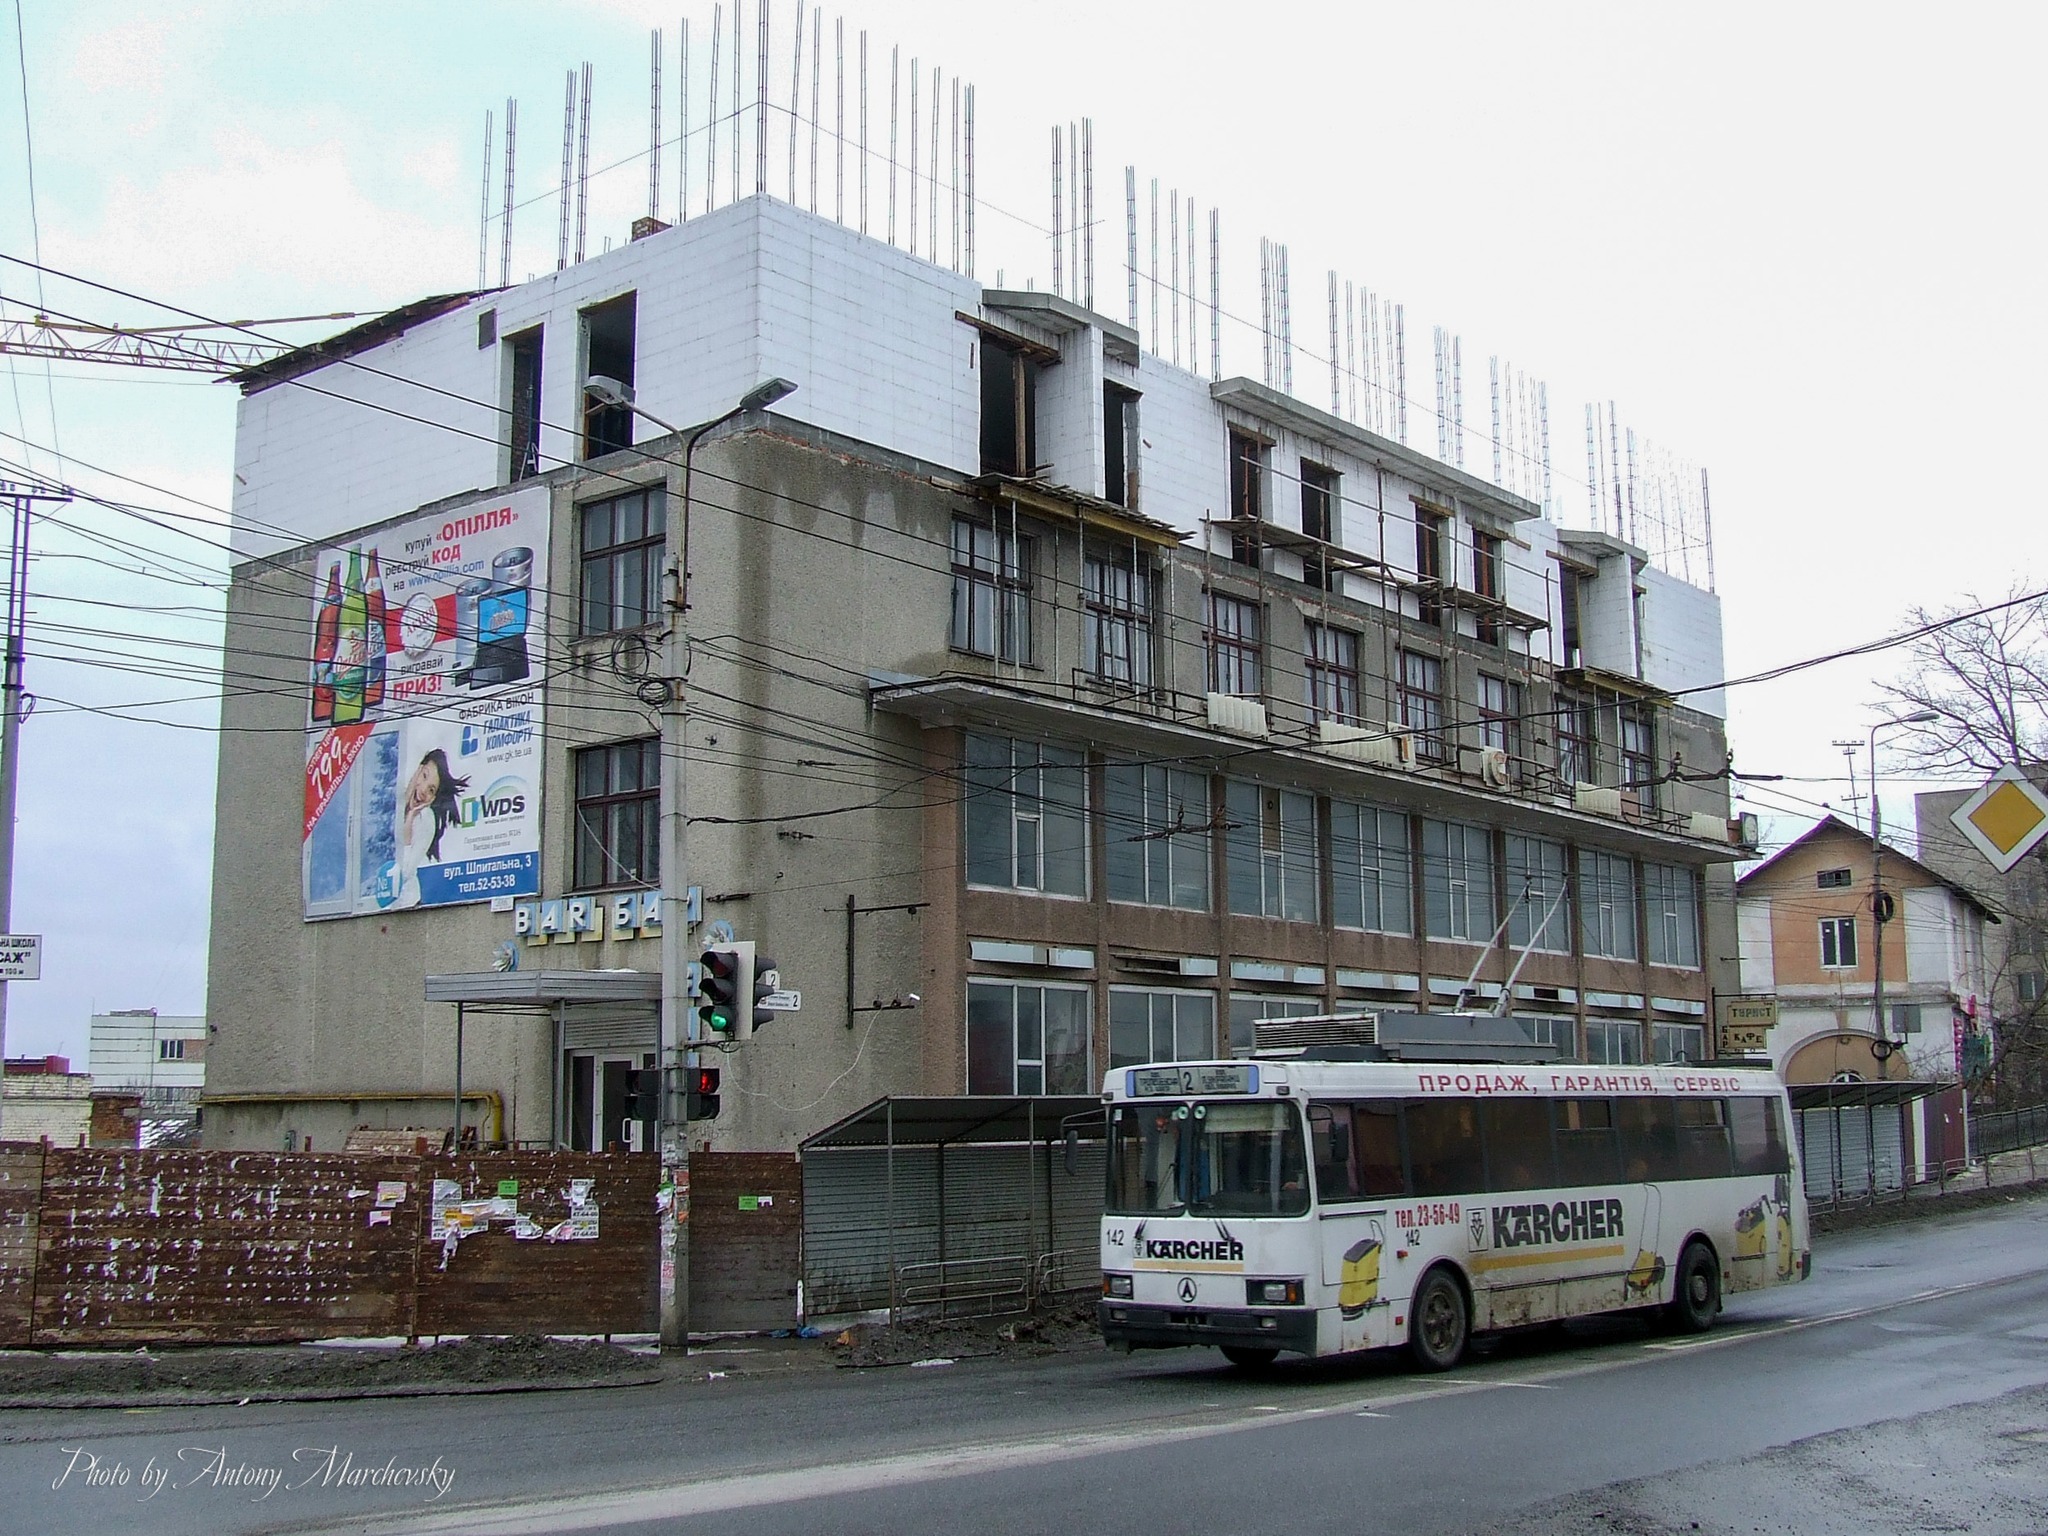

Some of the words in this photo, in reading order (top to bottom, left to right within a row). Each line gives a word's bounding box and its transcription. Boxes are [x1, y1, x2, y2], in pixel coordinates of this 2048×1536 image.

[405, 534, 432, 554] купуй
[436, 507, 518, 542] «ОПІЛЛЯ»
[432, 544, 461, 564] КОД
[393, 581, 405, 591] на
[400, 655, 444, 676] вигравай
[393, 675, 442, 700] ПРИЗ!
[459, 700, 504, 720] ФАБРИКА
[506, 692, 534, 710] ВІКОН
[483, 710, 531, 735] ГАЛАКТИКА
[485, 726, 534, 751] КОМФОРТУ
[480, 795, 526, 818] WDS
[444, 867, 464, 880] вул.
[525, 854, 532, 867] 3
[770, 973, 776, 987] 2
[792, 994, 798, 1008] 2
[1734, 1032, 1763, 1044] КАФЕ
[1183, 1071, 1195, 1091] 2
[1418, 1075, 1538, 1094] ПРОДАЖ,
[1550, 1076, 1658, 1095] ГАРАНТІЯ,
[1673, 1077, 1742, 1092] СЕРВІС
[1395, 1210, 1416, 1228] тел.
[1417, 1203, 1460, 1227] 23-56-49
[1106, 1229, 1125, 1246] 142
[1405, 1229, 1421, 1247] 142
